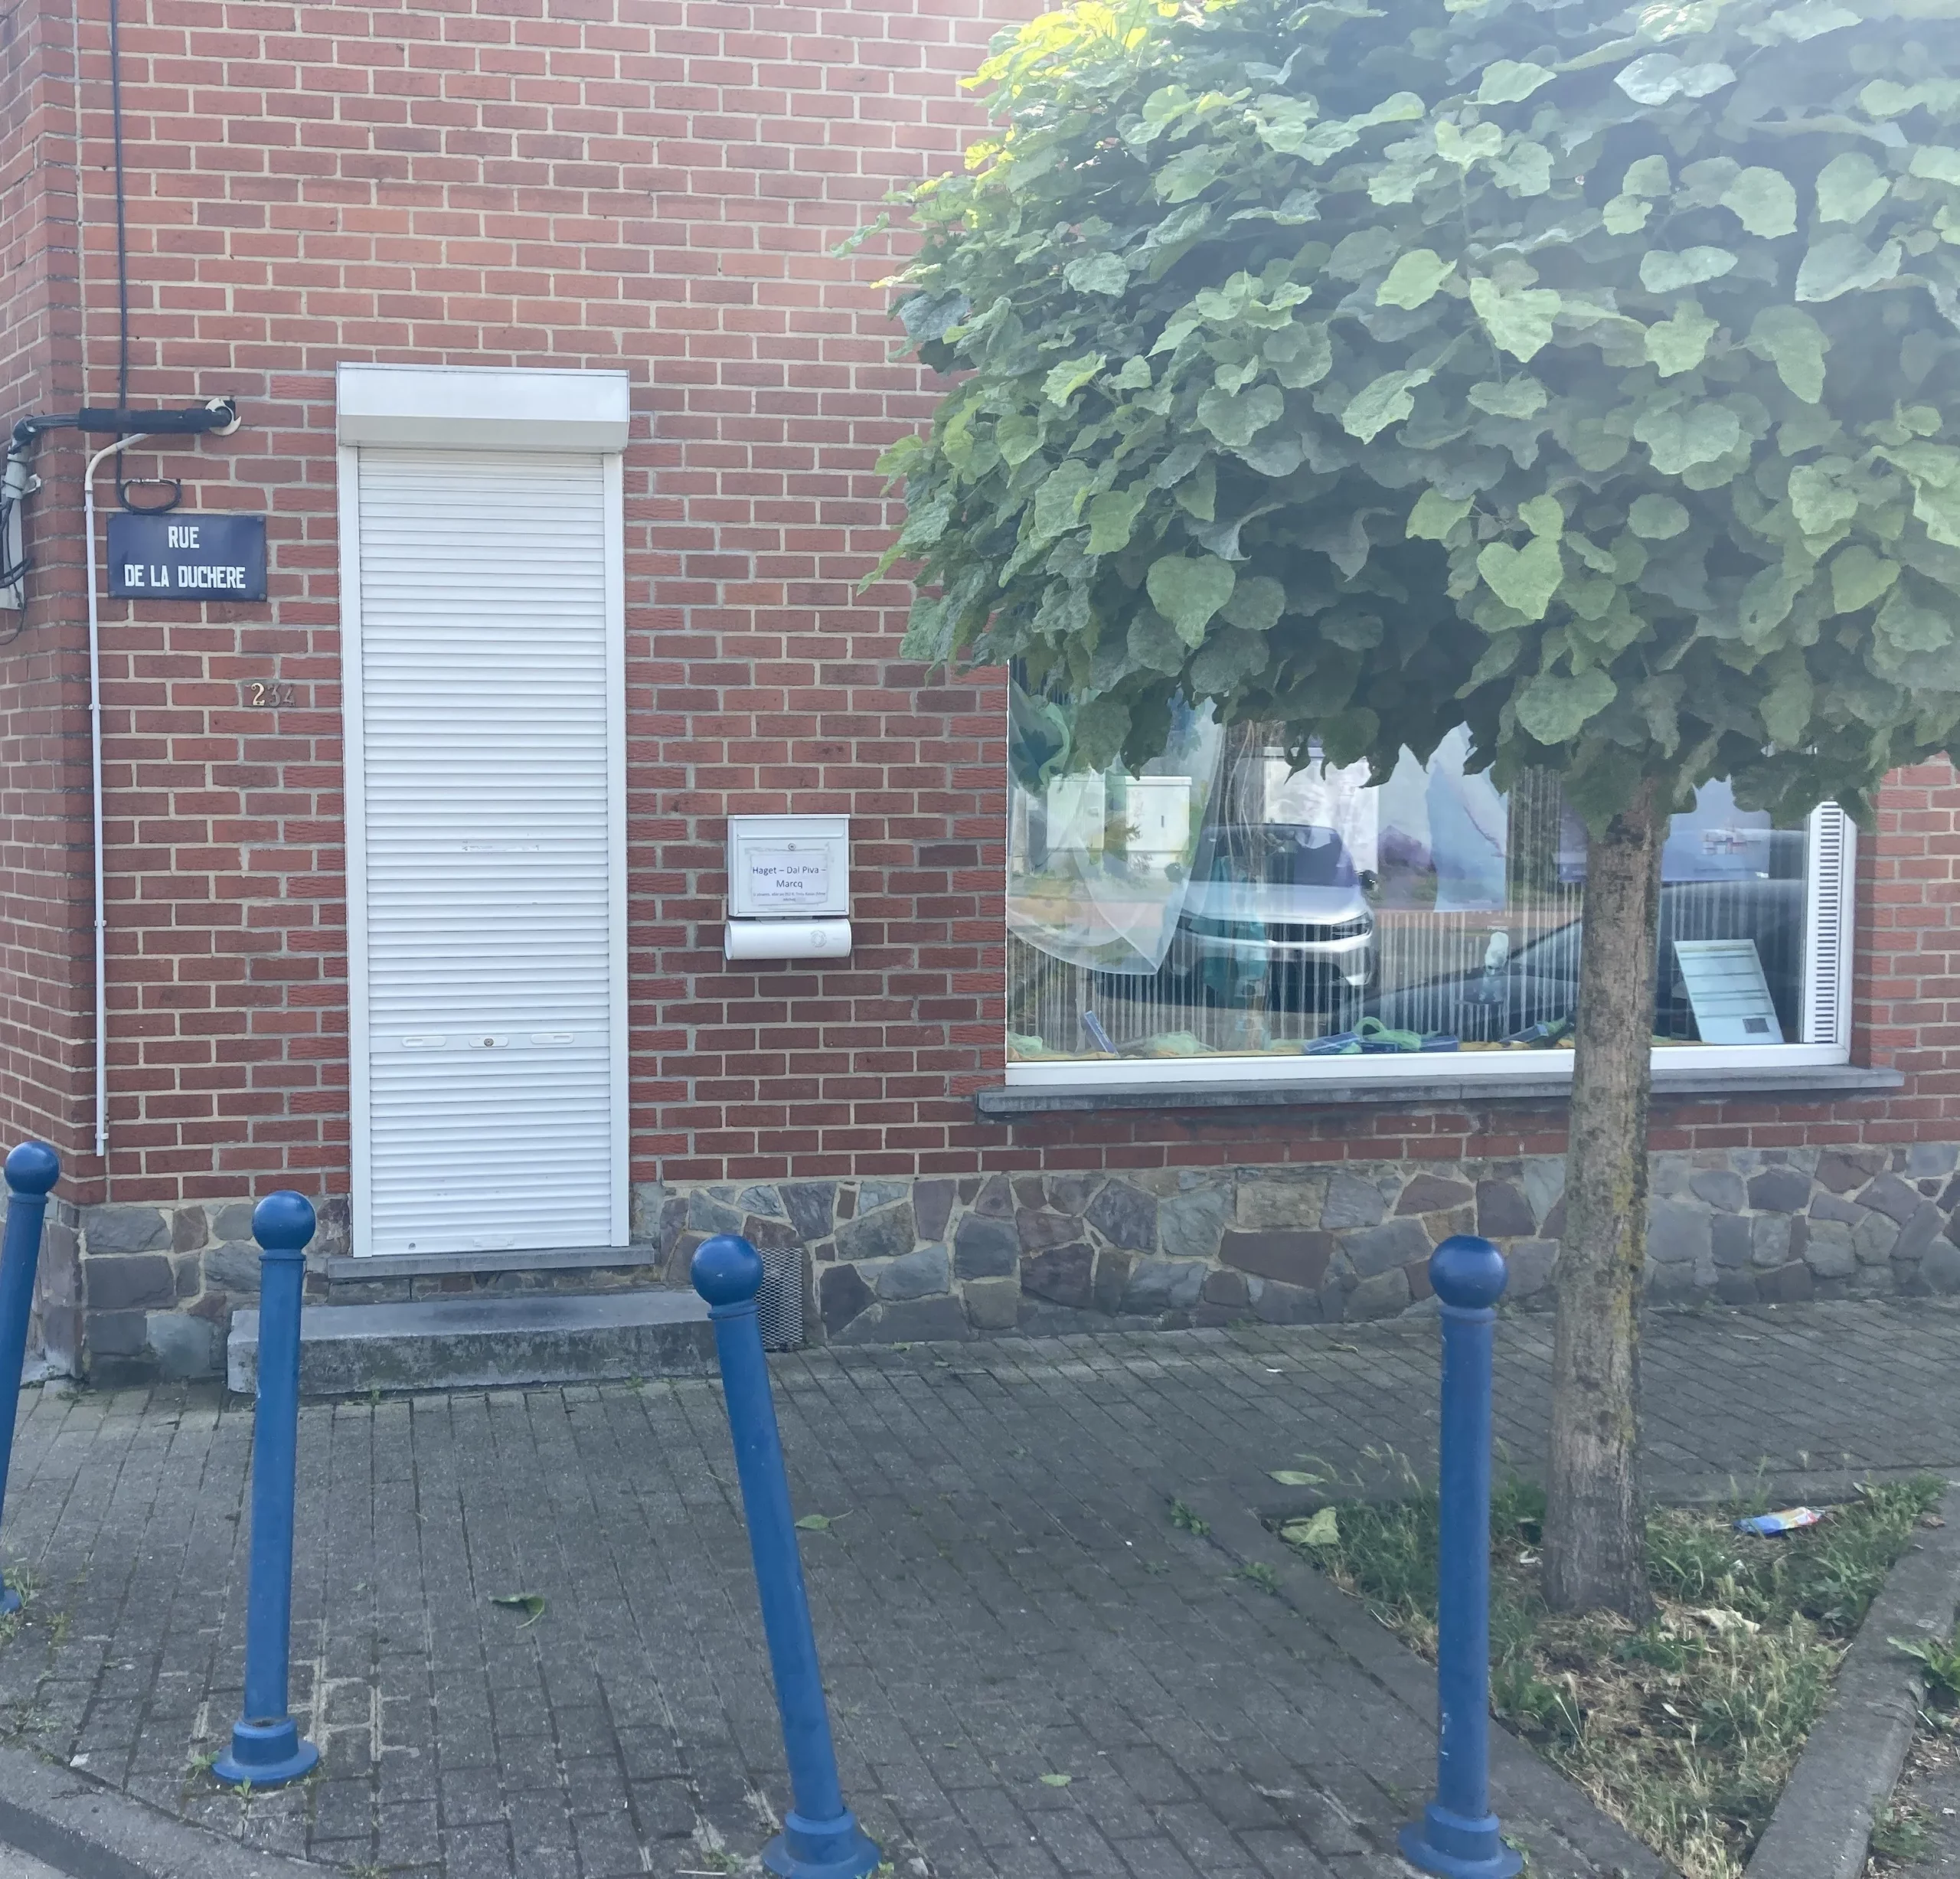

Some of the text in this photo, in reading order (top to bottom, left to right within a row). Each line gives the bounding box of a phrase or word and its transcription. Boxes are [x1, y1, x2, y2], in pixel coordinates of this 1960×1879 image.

[168, 526, 199, 548] RUE
[124, 564, 246, 588] DE LA DUCHERE
[251, 682, 296, 707] 234
[753, 866, 776, 876] Haget
[776, 880, 802, 888] Marcq
